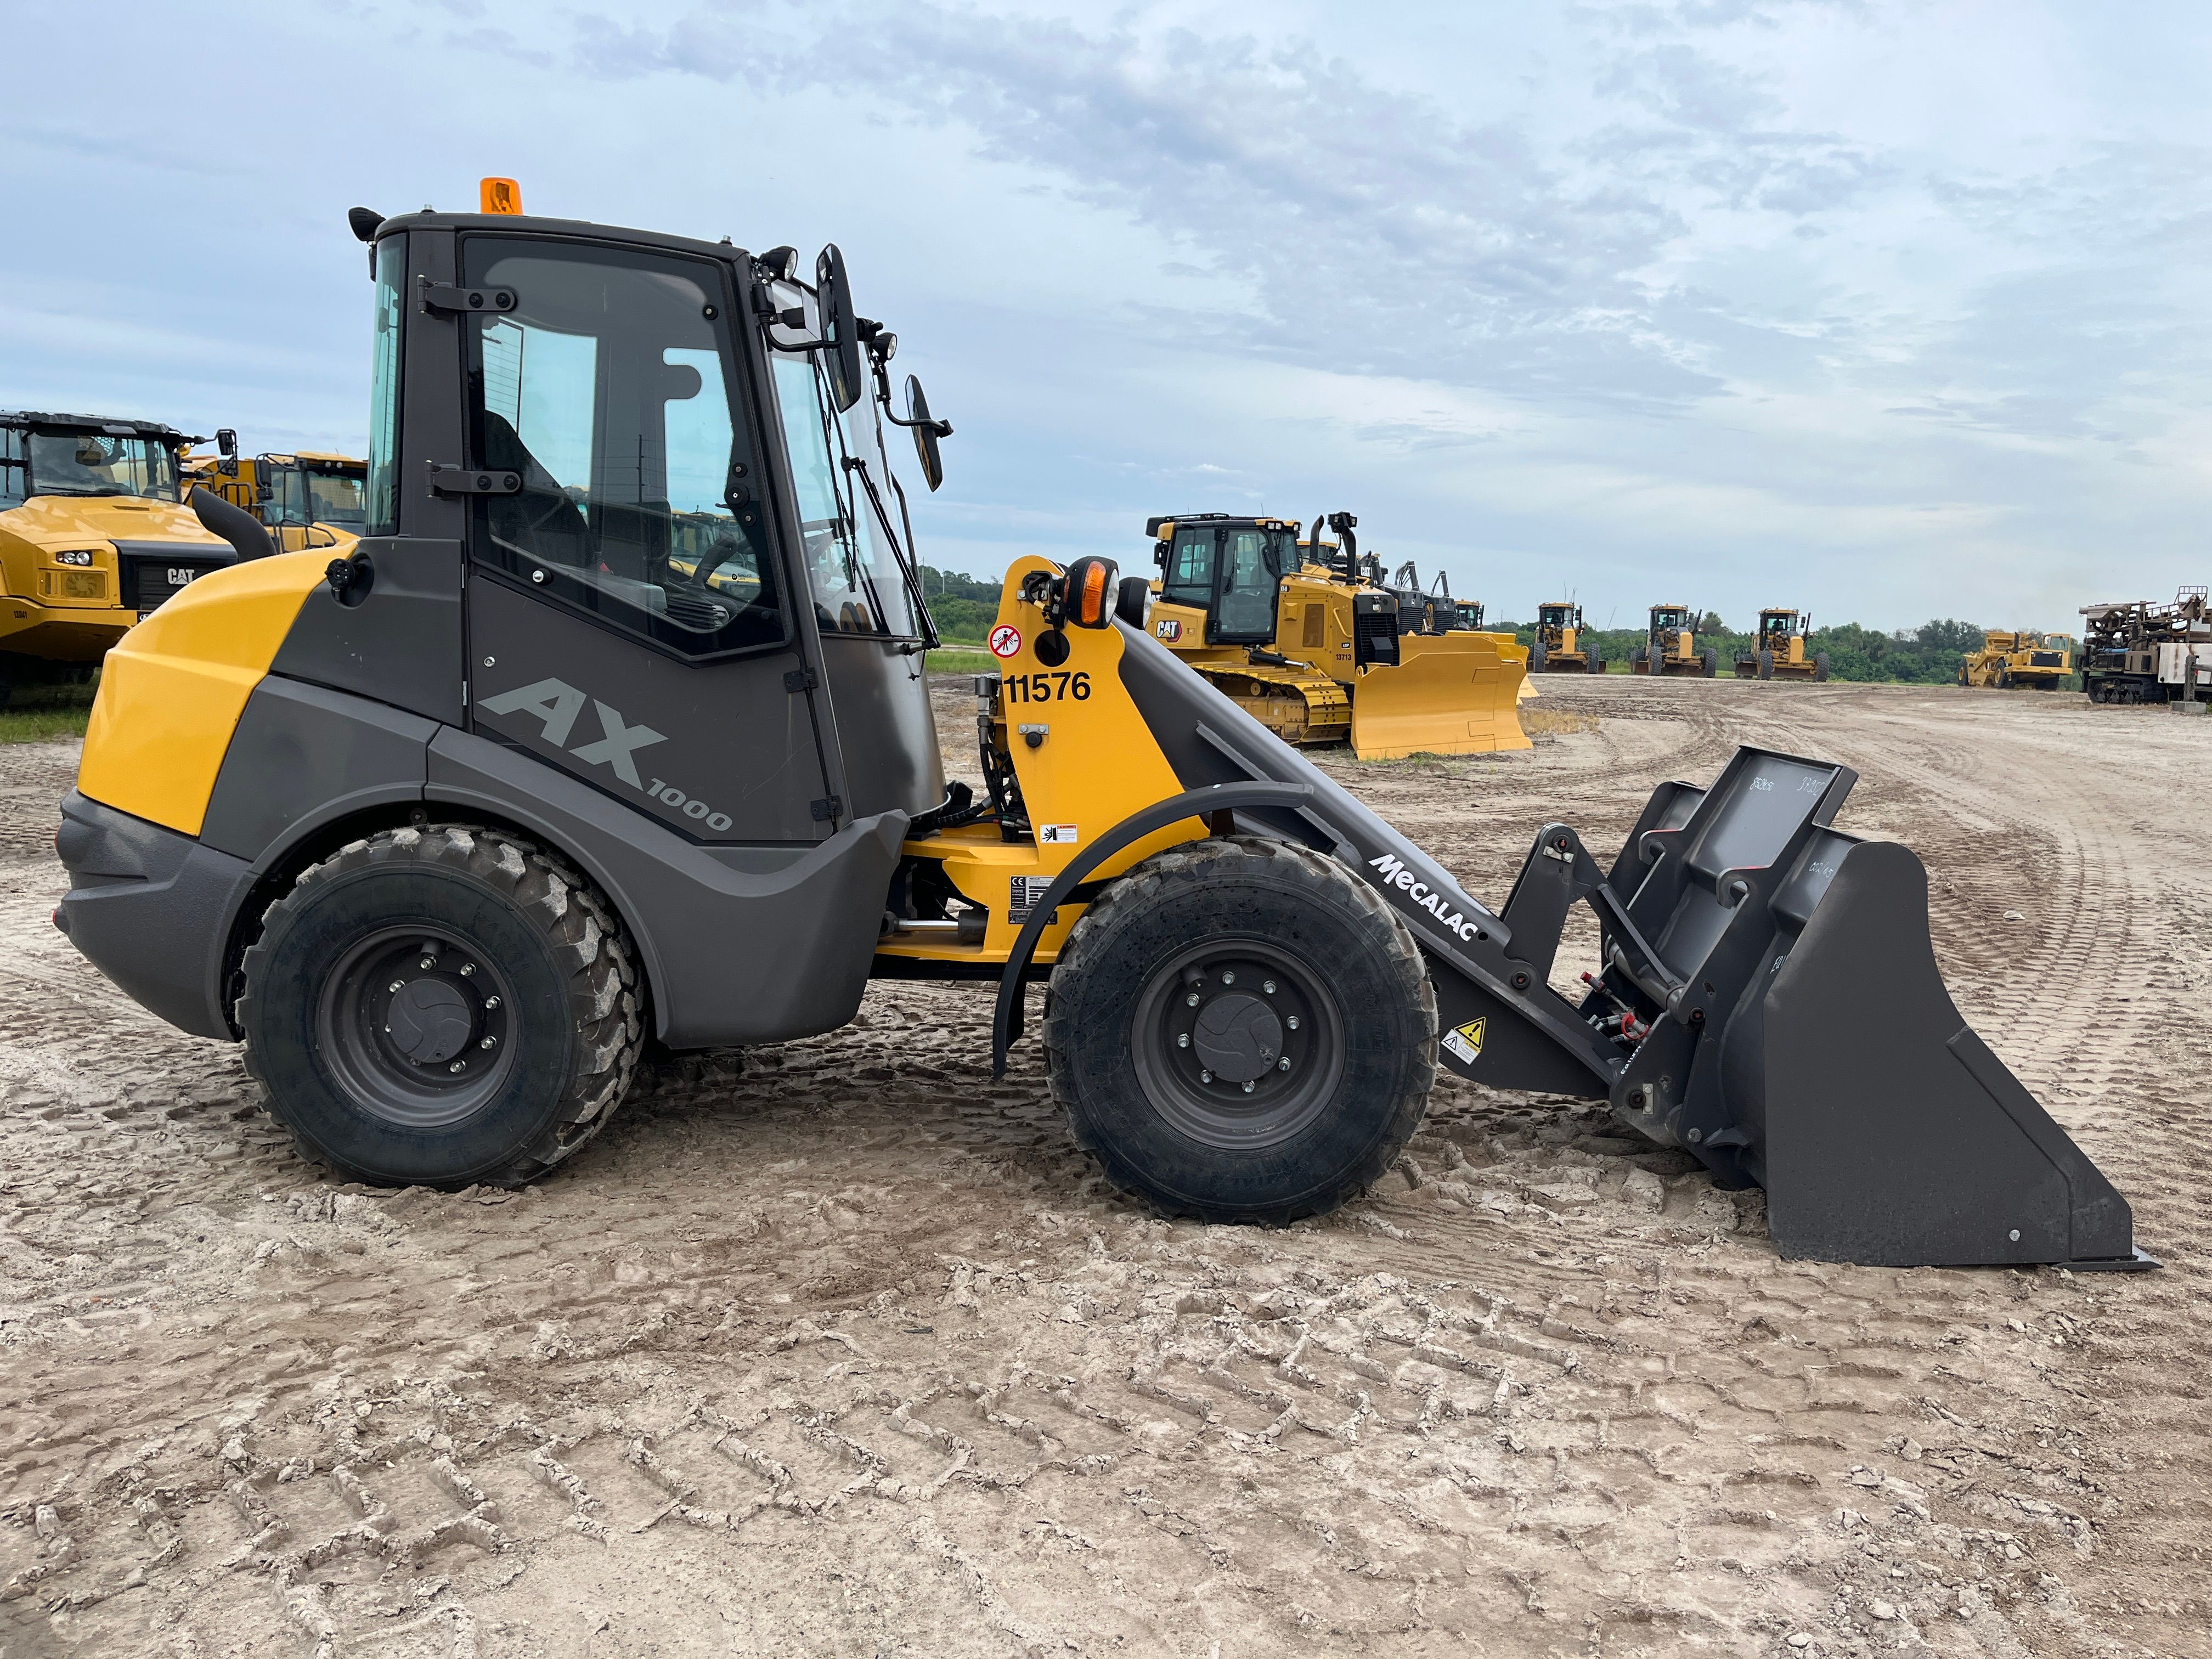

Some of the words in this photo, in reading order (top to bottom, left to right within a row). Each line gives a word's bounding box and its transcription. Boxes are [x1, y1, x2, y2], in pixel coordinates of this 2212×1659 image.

[167, 568, 195, 584] CAT
[1361, 567, 1370, 577] CAT
[1156, 621, 1178, 637] CAT
[1003, 672, 1091, 703] 11576
[477, 677, 669, 791] AX
[647, 778, 733, 832] 1000
